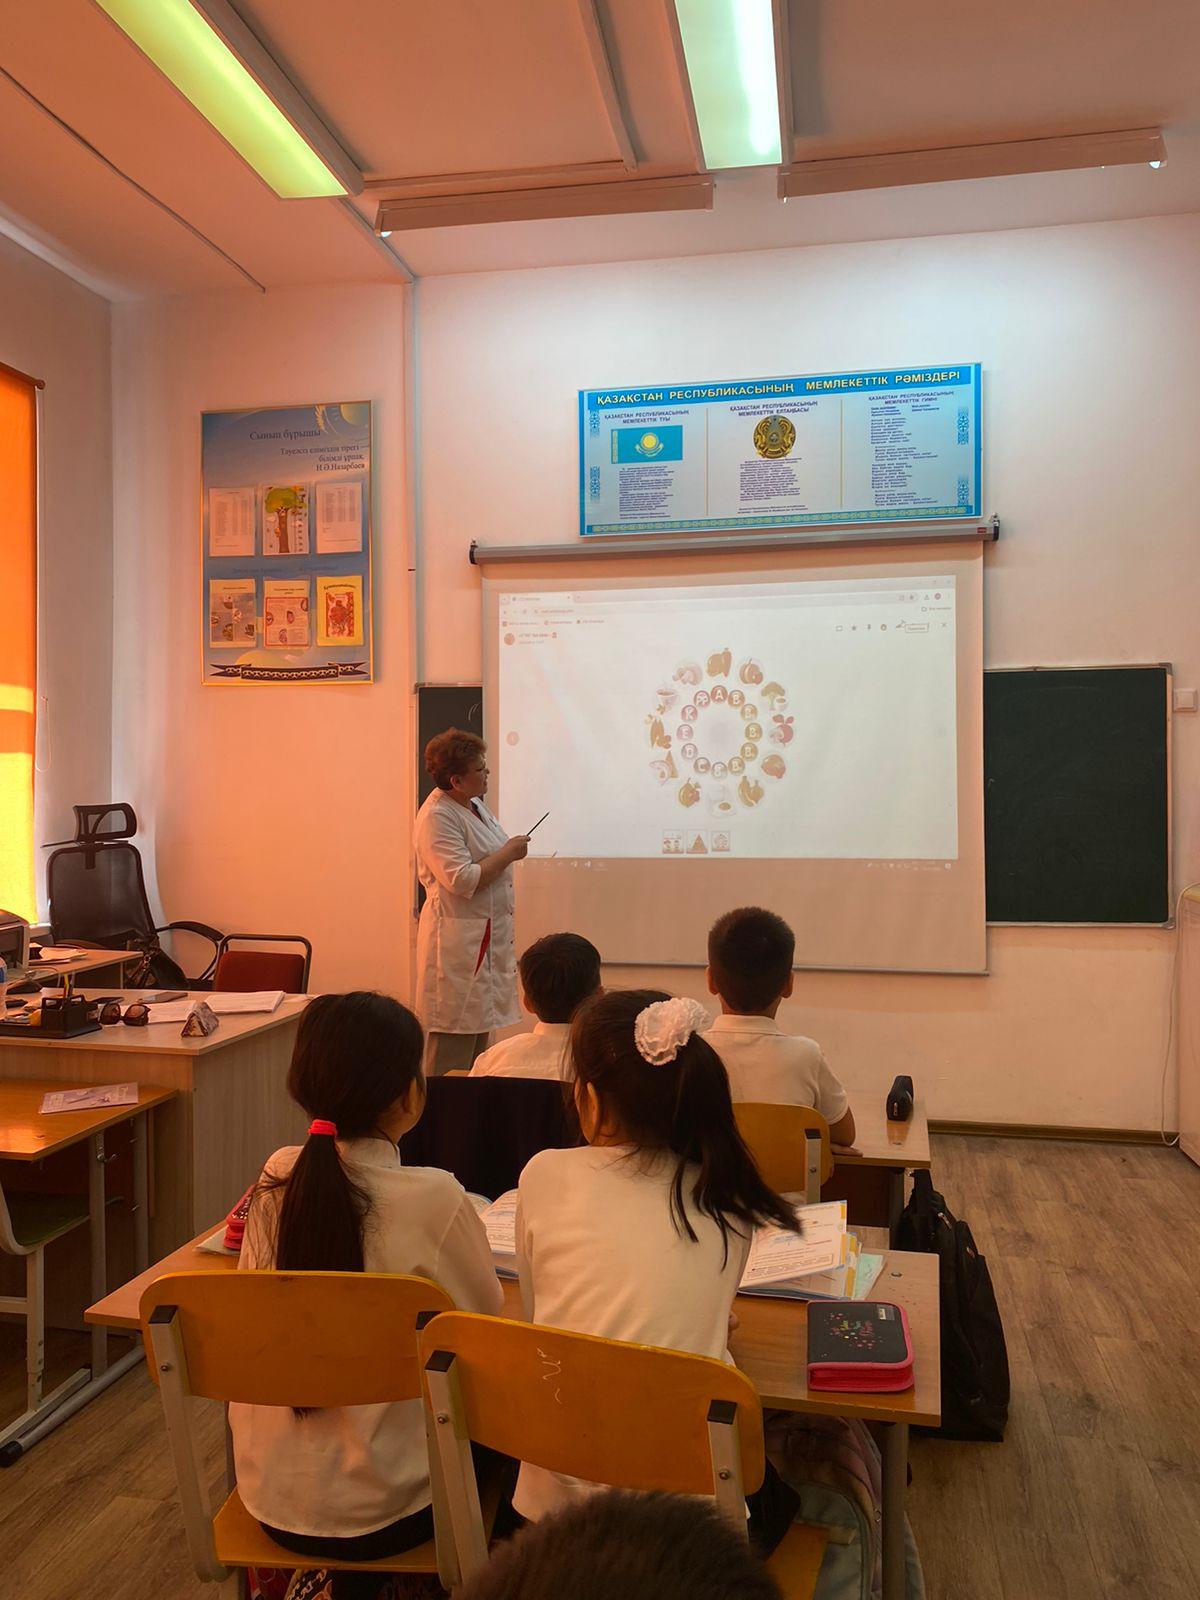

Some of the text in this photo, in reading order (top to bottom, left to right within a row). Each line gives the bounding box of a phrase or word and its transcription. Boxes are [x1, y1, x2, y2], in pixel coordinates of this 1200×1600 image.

[597, 371, 960, 406] ҚАЗАҚСТАН РЕСПУБЛИКАСЫНЫҢ МЕМЛЕКЕТТІК РӘМІЗДЕРІ
